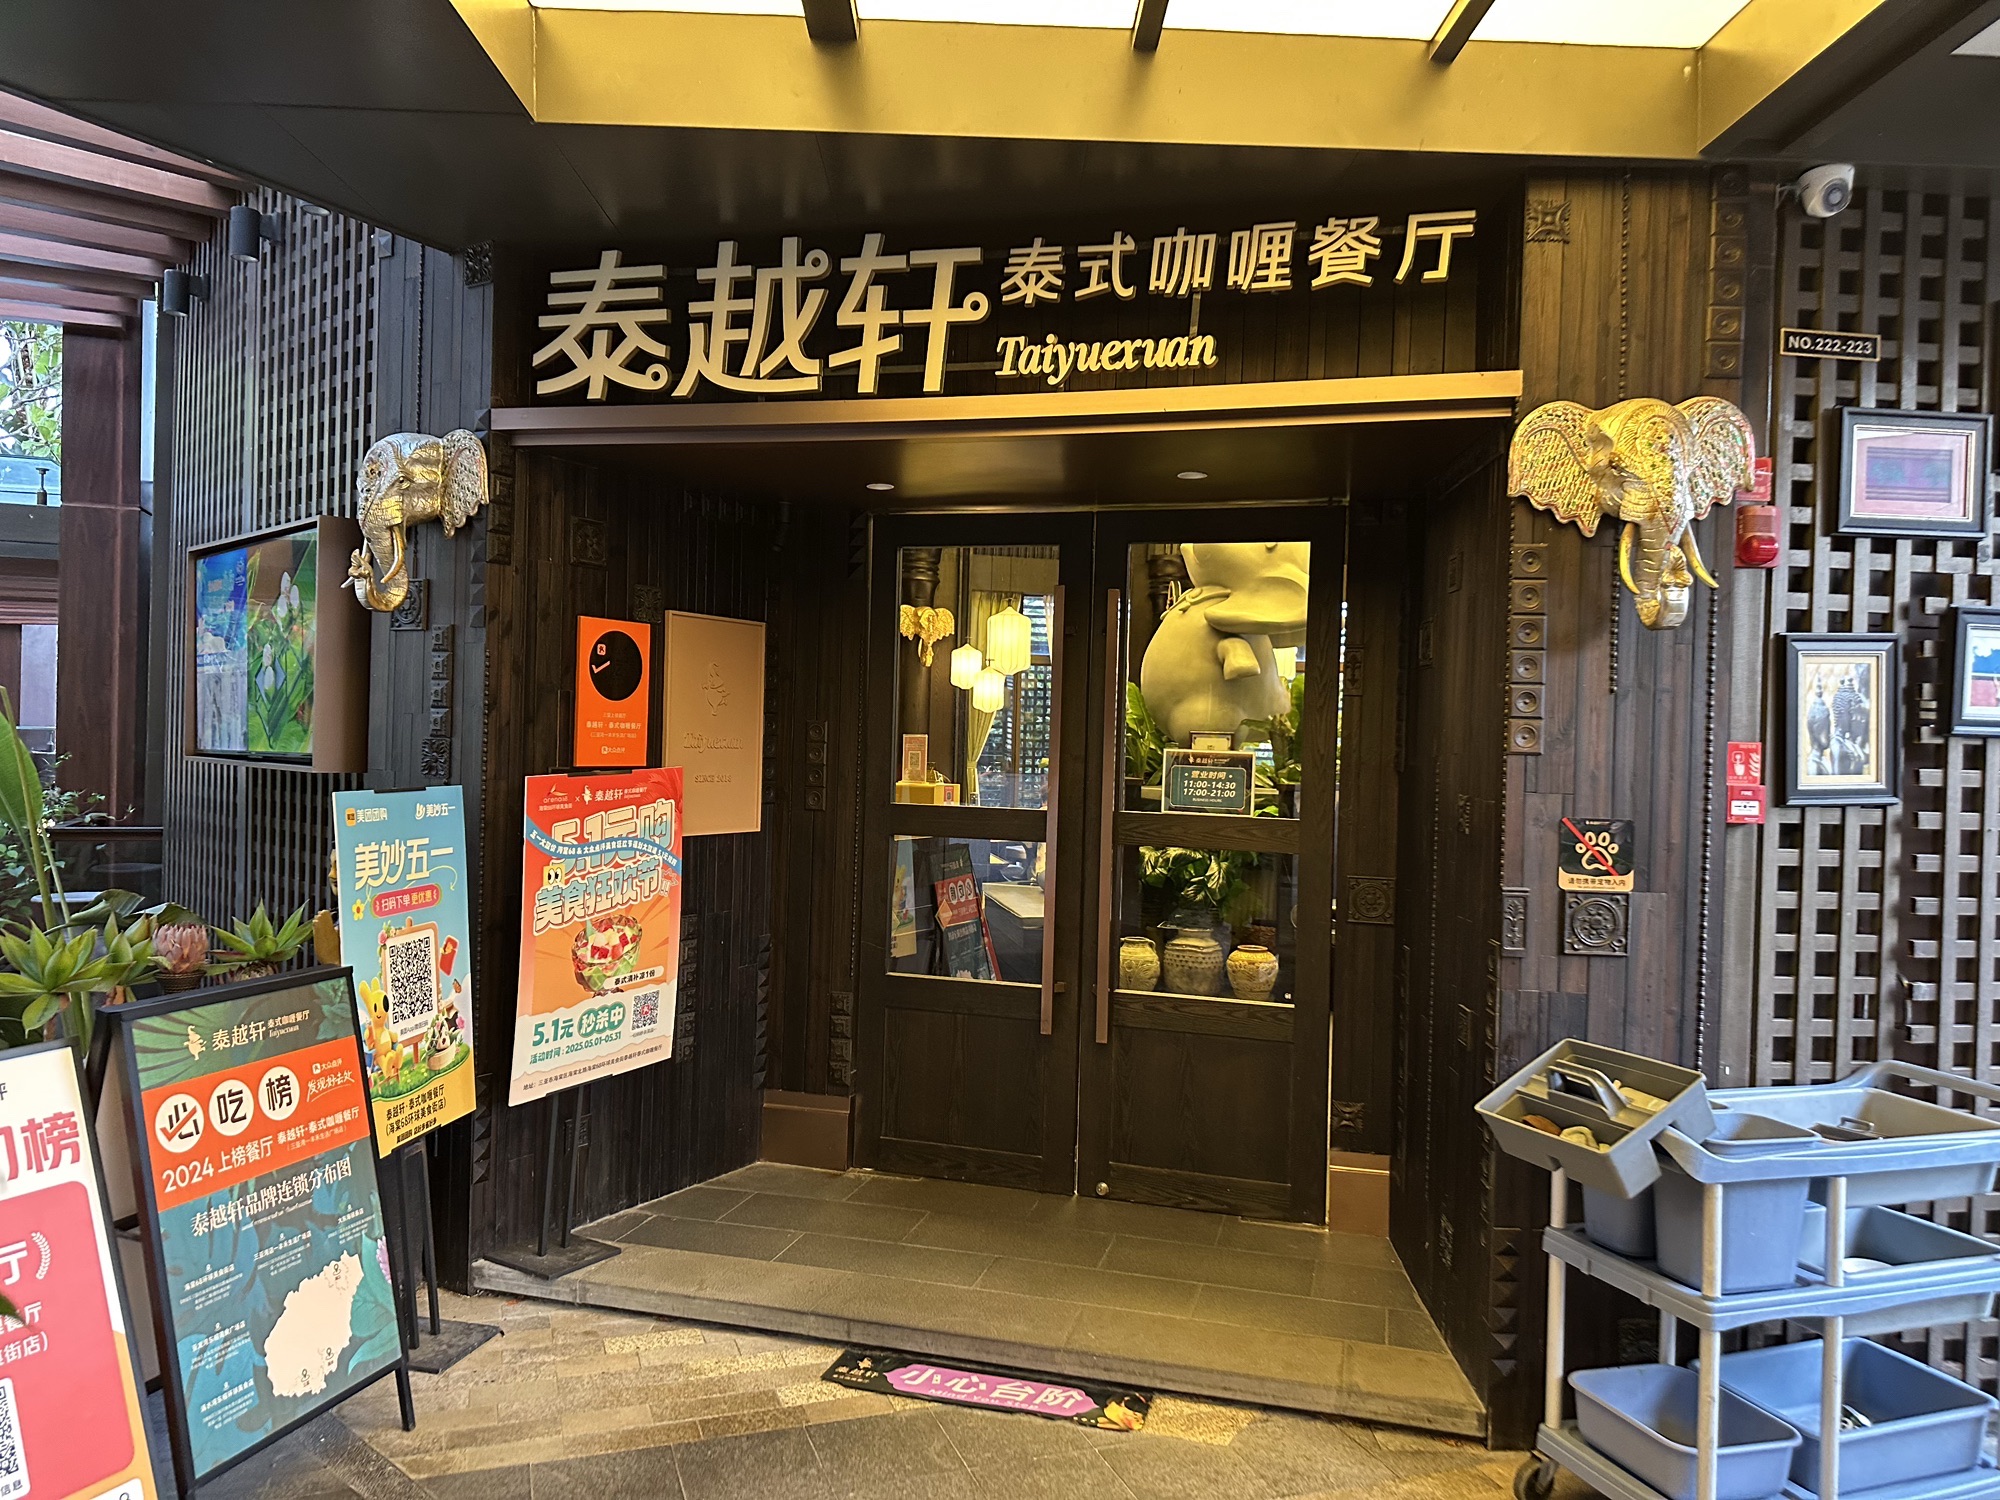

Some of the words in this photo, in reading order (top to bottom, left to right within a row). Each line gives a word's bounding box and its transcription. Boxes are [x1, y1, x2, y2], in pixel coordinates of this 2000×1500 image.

[1001, 209, 1477, 306] 泰式咖喱餐厅
[533, 232, 989, 399] 泰越轩
[994, 332, 1219, 386] Taiyuexuan
[1788, 335, 1873, 355] NO.222-223
[1184, 780, 1237, 789] 11:00-14:30
[1191, 770, 1227, 779] 营业时间
[594, 789, 623, 802] 泰越轩
[1184, 788, 1236, 798] 17:00-21:00
[356, 807, 388, 823] 美团团购
[425, 803, 456, 817] 美妙五一
[355, 837, 454, 891] 美妙五一
[535, 857, 661, 934] 美食狂欢节
[1568, 877, 1626, 887] 请勿携带宠物入内
[381, 893, 411, 912] 扫码下单
[411, 889, 433, 905] 更优惠
[267, 1009, 311, 1029] 泰式咖喱餐厅
[532, 1017, 574, 1047] 5.1元
[579, 1006, 624, 1036] 秒杀中
[211, 1021, 266, 1052] 泰越轩
[321, 1058, 342, 1071] 大众点评
[307, 1070, 356, 1099] 发现好去处
[159, 1074, 294, 1142] 必吃榜
[276, 1106, 360, 1145] 泰越轩·泰式咖喱餐厅
[162, 1157, 215, 1194] 2024
[217, 1136, 274, 1174] 上榜餐厅
[190, 1156, 352, 1237] 泰越轩品牌连锁分布图
[900, 1368, 1084, 1409] 小心台阶
